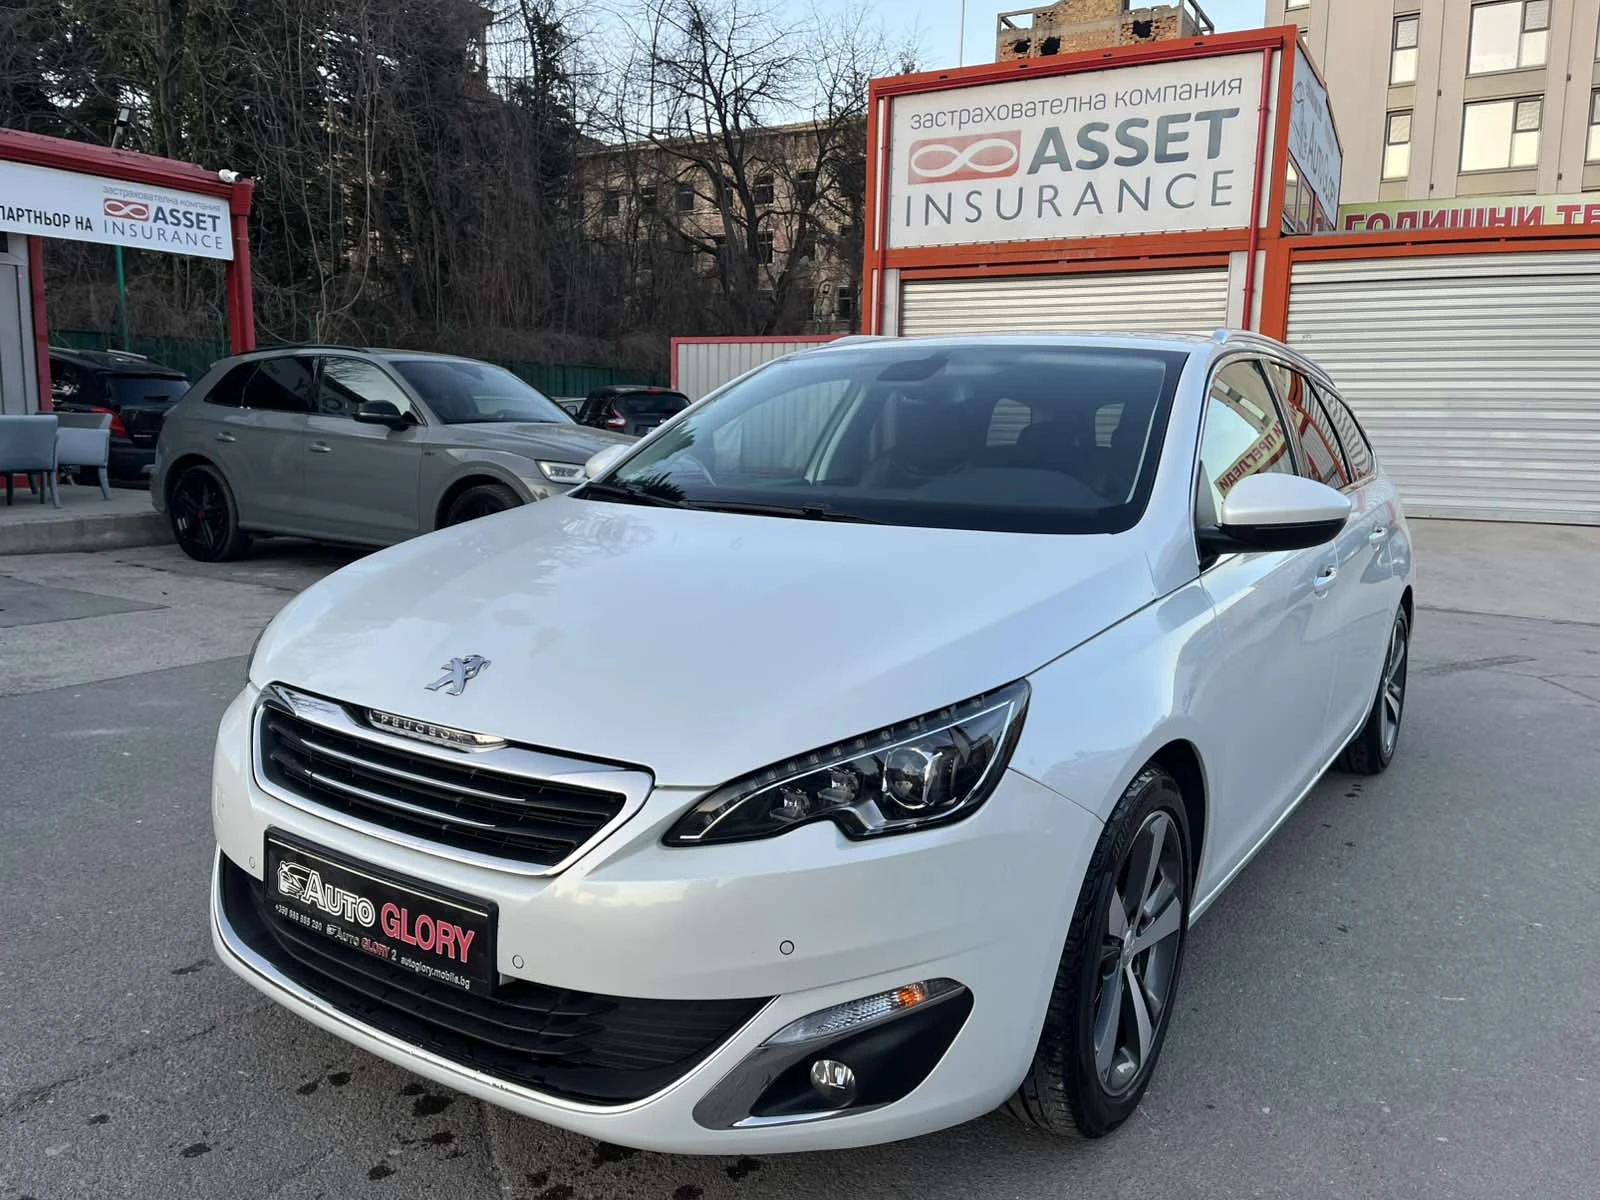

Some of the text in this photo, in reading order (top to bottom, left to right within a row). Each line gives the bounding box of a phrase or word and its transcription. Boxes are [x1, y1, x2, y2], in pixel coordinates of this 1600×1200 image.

[910, 77, 1243, 130] застрахователна компания
[1026, 108, 1240, 175] ASSET
[905, 169, 1234, 227] INSURANCE
[75, 215, 93, 231] НА
[104, 220, 223, 249] INSURANCE
[152, 206, 220, 232] ASSET
[380, 713, 464, 744] PEUGEOT
[380, 902, 475, 963] GLORY
[391, 949, 397, 961] 2
[400, 956, 470, 990] autoglory.mobile.bg
